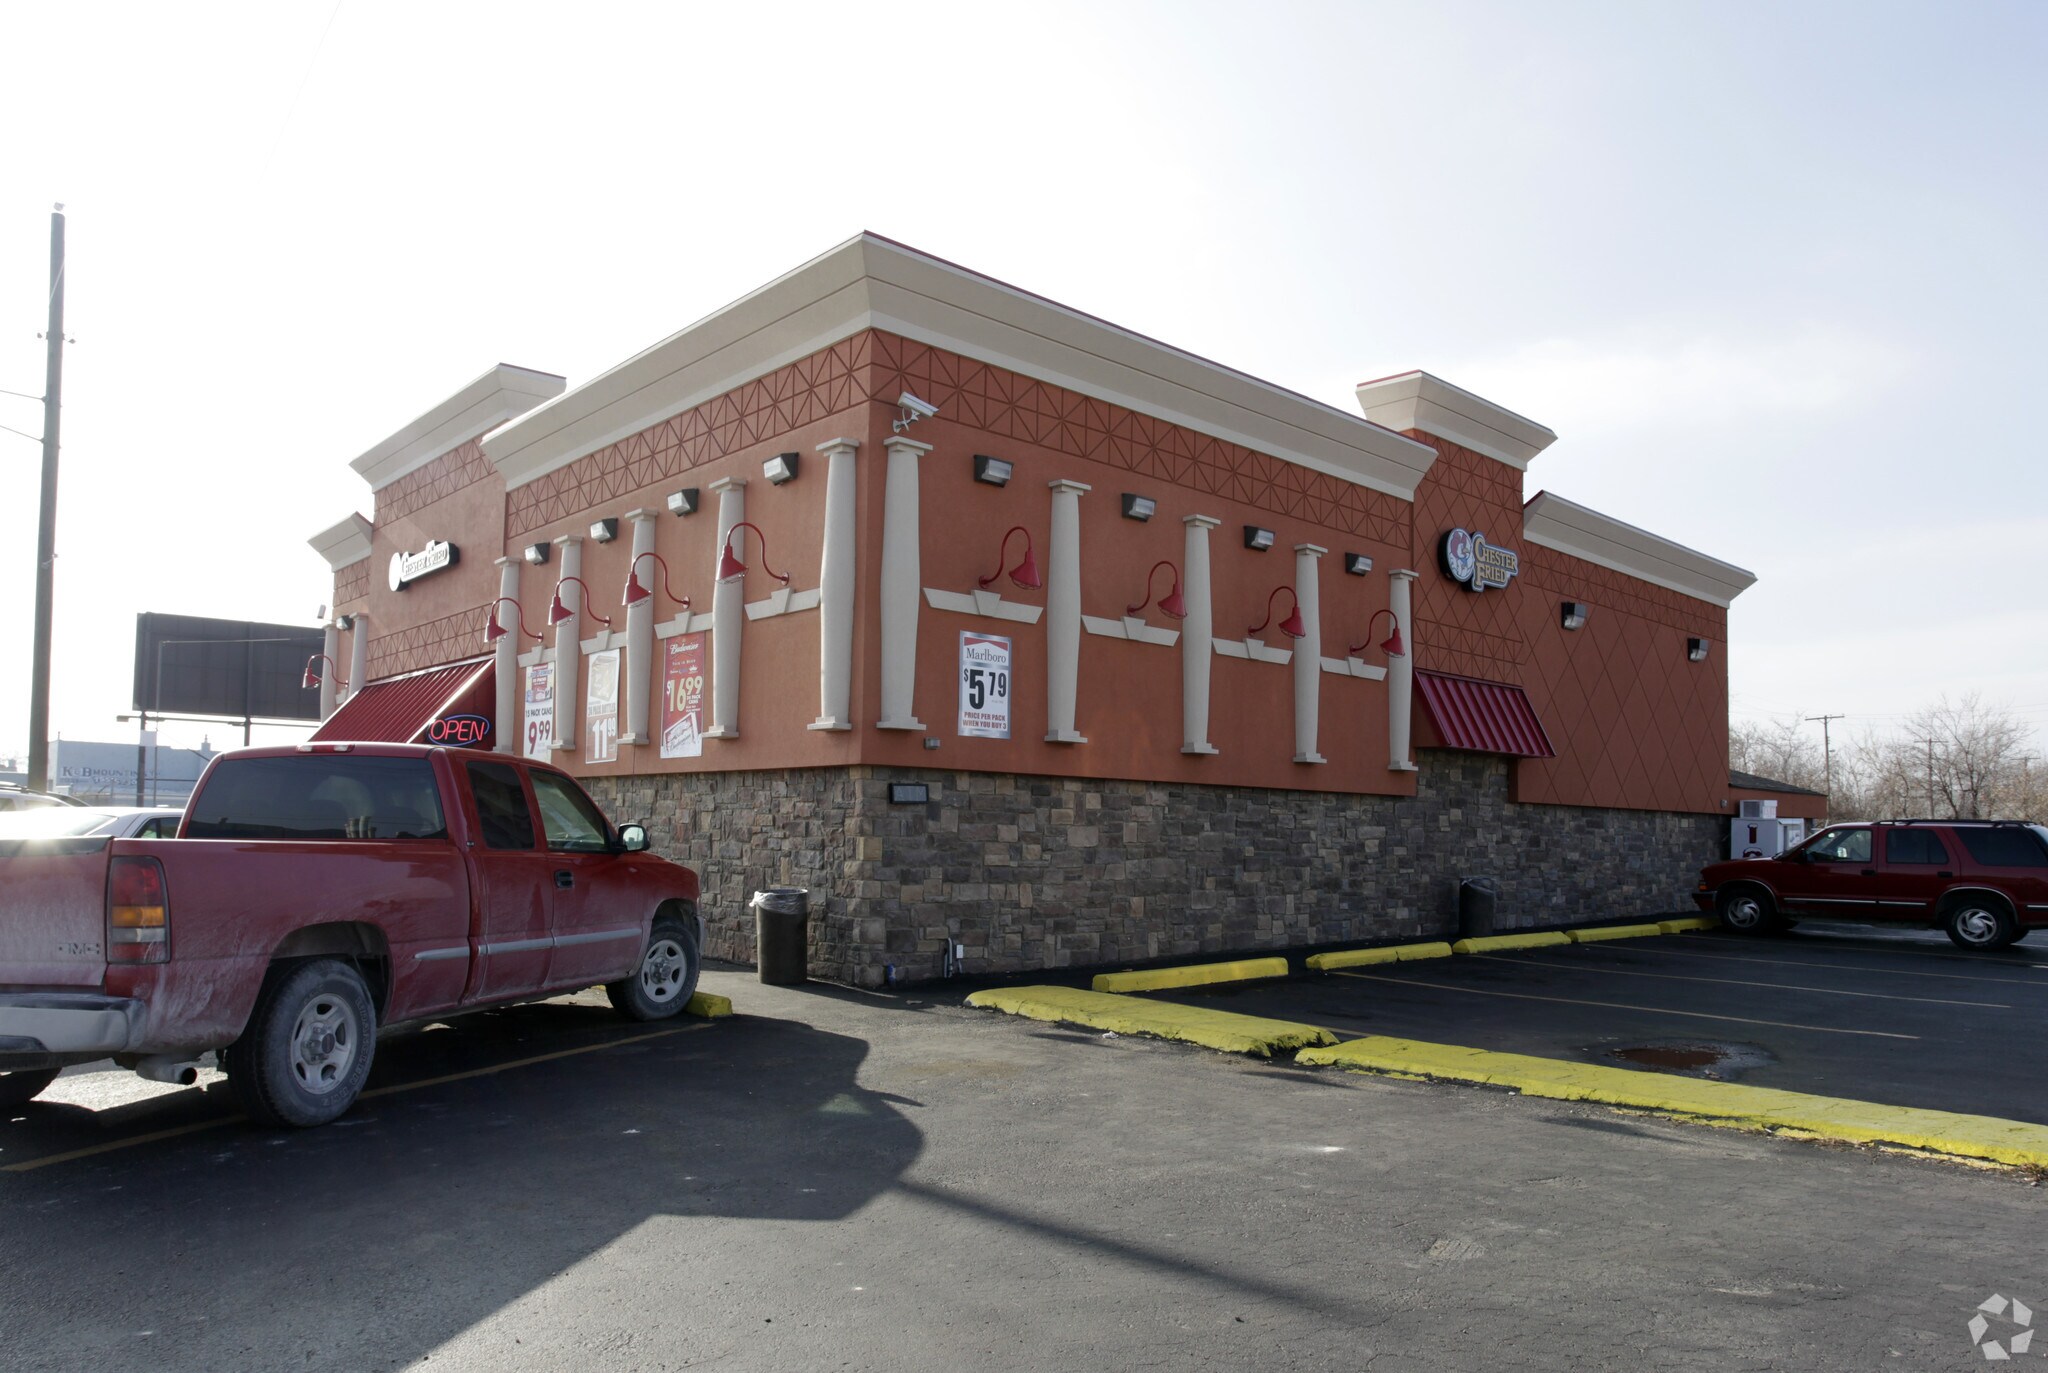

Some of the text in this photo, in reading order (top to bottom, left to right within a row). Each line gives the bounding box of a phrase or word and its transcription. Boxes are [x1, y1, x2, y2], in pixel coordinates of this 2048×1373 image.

[1474, 537, 1517, 570] CHESTER
[1475, 562, 1507, 586] FRIED
[670, 642, 699, 655] Budweiser
[966, 647, 1007, 664] Marlboro
[530, 708, 541, 717] PACK
[541, 707, 553, 716] CANS
[964, 711, 1006, 722] PRICE PER PACK
[430, 719, 485, 741] OPEN
[962, 719, 980, 729] WHEN
[980, 720, 991, 729] YOU
[991, 721, 1003, 730] BUY
